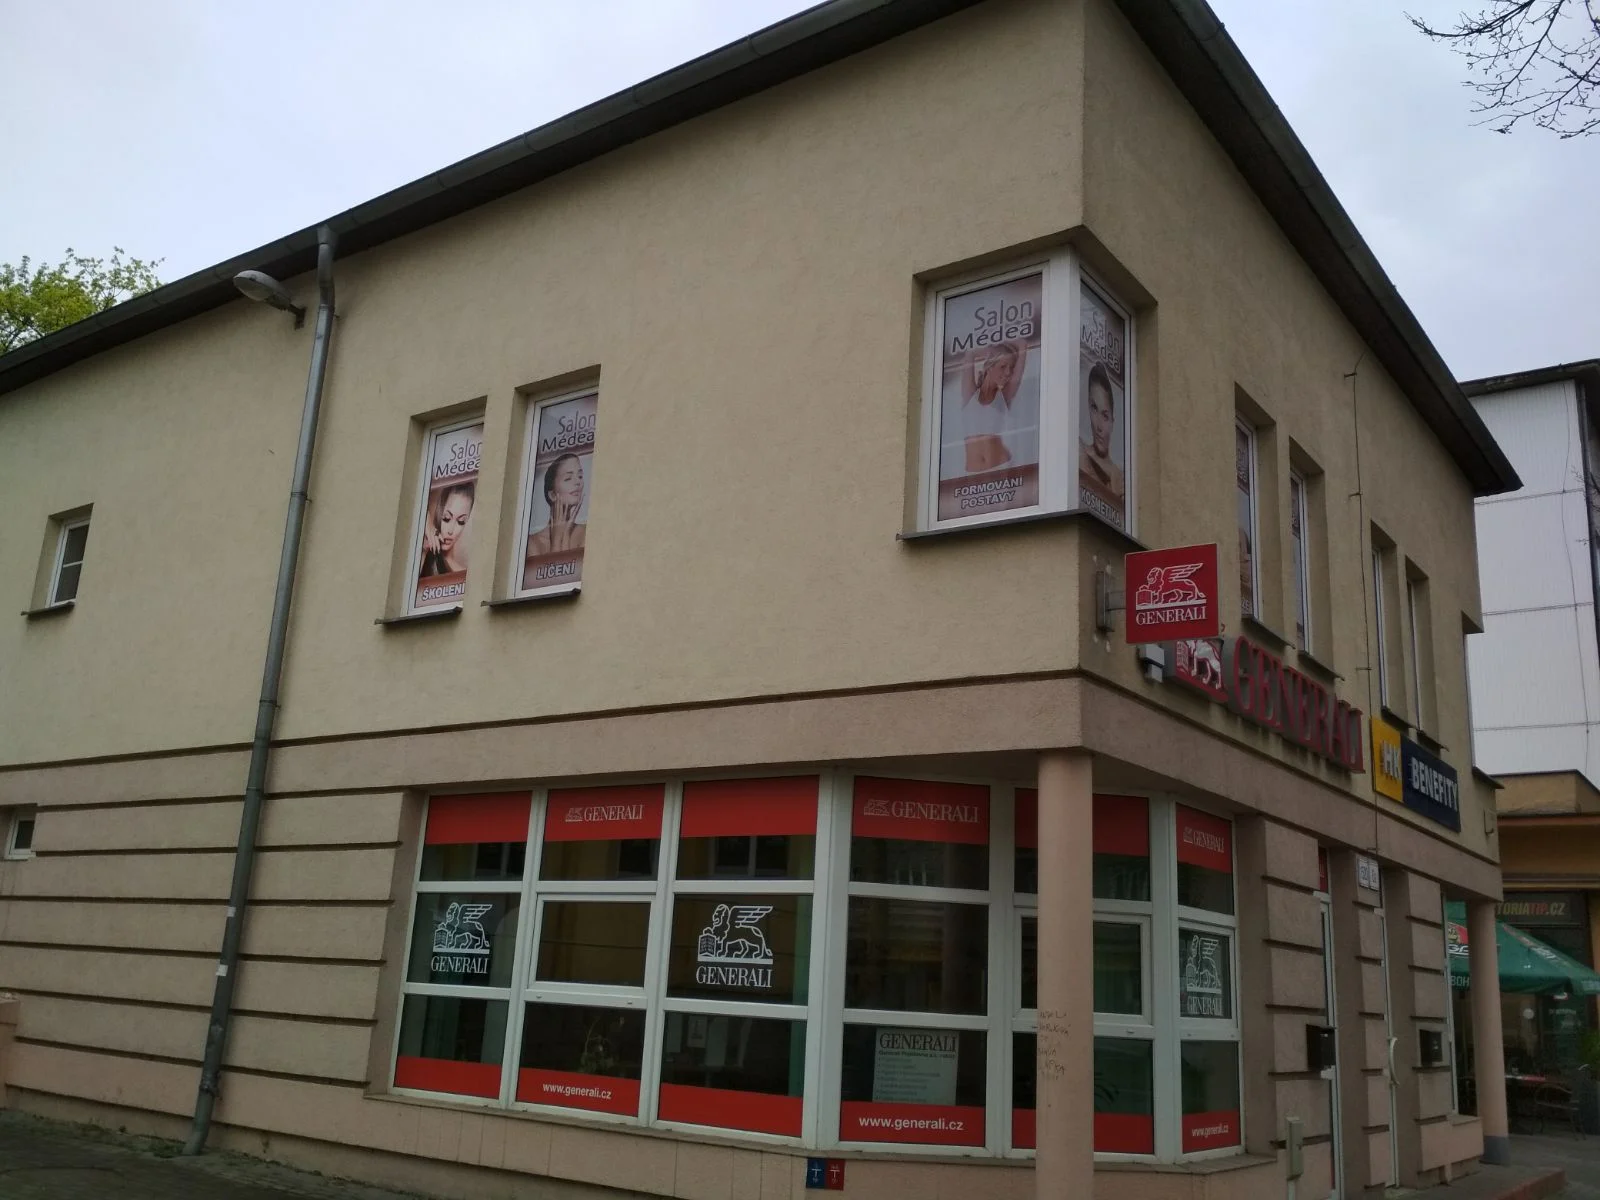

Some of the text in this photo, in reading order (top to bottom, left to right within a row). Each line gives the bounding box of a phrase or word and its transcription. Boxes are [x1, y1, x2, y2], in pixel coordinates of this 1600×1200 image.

[974, 300, 1032, 330] Salon
[952, 322, 1032, 353] Médea
[1093, 311, 1120, 353] Salon
[1081, 324, 1120, 371] Médea
[557, 410, 596, 435] Salon
[542, 431, 595, 452] Médea
[961, 490, 1016, 509] POSTAVY
[1081, 488, 1121, 527] KOSMETIKA
[1136, 606, 1208, 625] GENERALI
[1233, 635, 1366, 774] GENERALI
[1410, 756, 1458, 812] BENEFITY
[583, 804, 645, 822] GENERALI
[891, 800, 980, 824] GENERALI
[1193, 830, 1225, 854] GENERALI
[430, 955, 489, 974] GENERALI
[696, 966, 773, 988] GENERALI
[1187, 996, 1224, 1017] GENERALI
[879, 1032, 957, 1052] GENERALI
[542, 1083, 612, 1100] www.generali.cz
[859, 1115, 964, 1131] www.generali.cz
